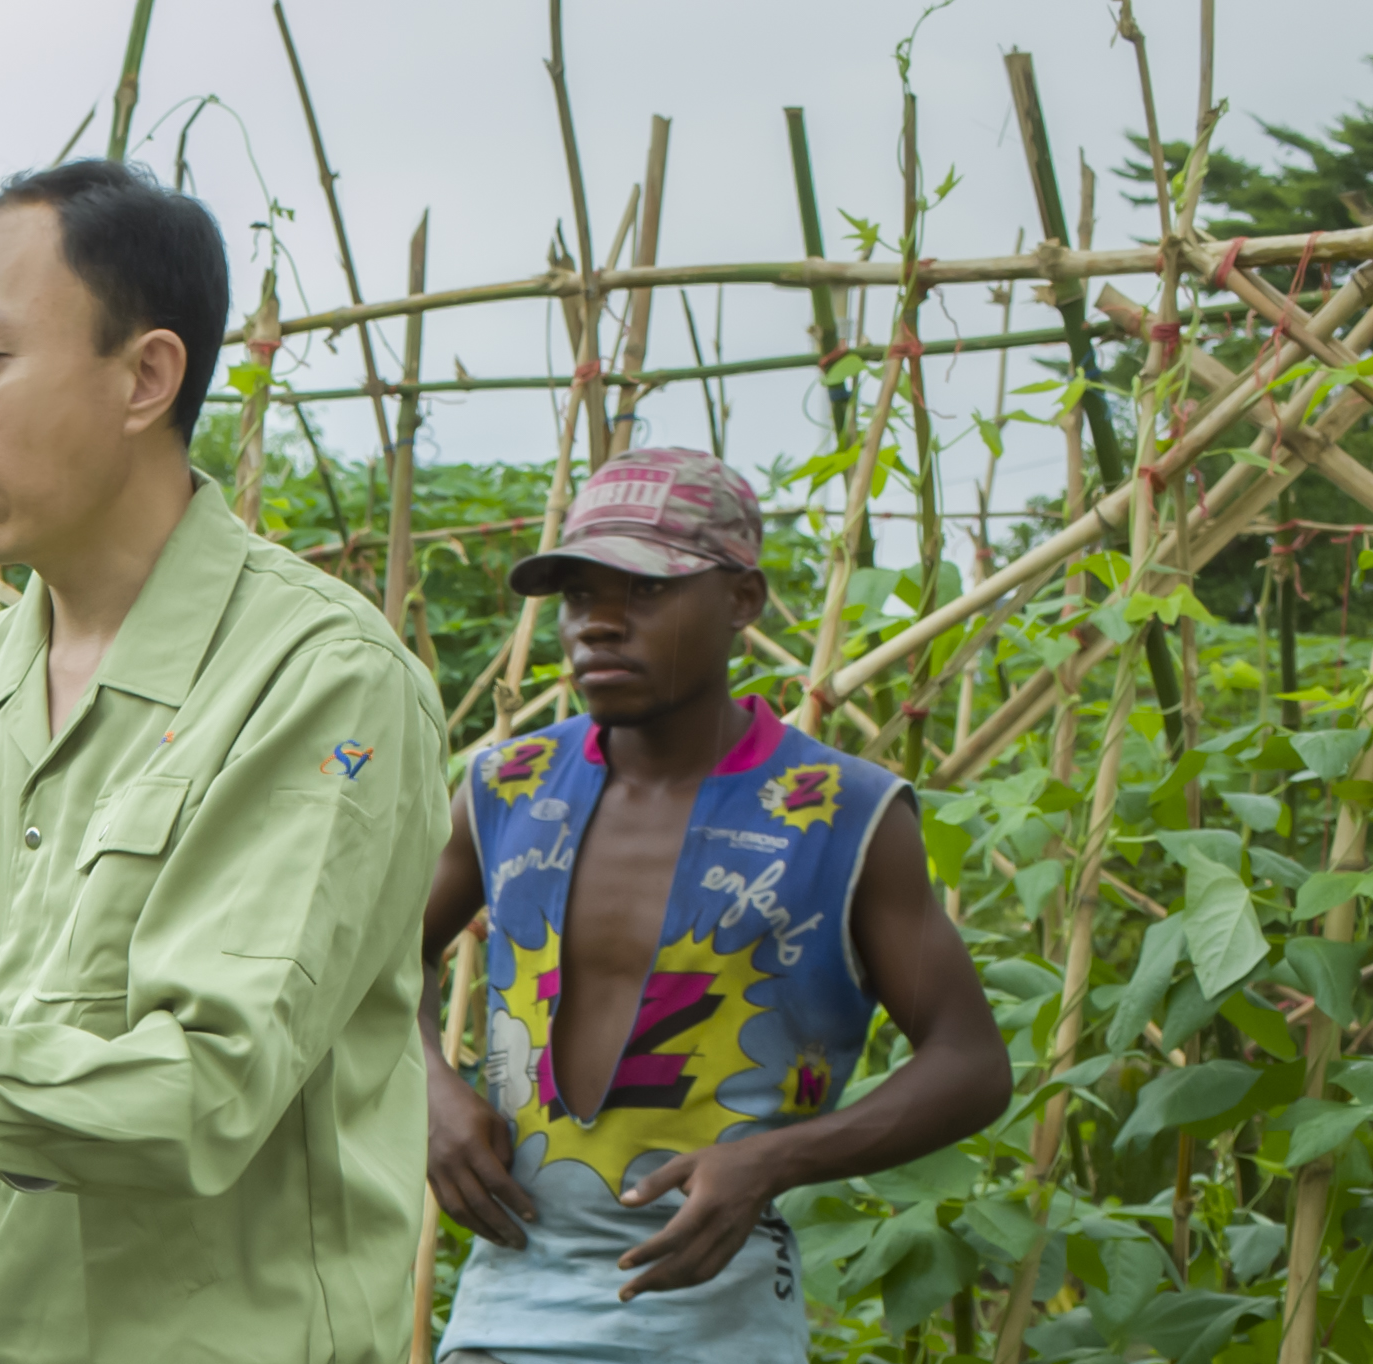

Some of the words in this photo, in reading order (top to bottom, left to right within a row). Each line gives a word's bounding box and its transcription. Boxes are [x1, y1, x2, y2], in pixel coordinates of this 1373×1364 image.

[497, 743, 546, 785] Z
[782, 765, 830, 813] Z
[699, 858, 825, 967] enfants
